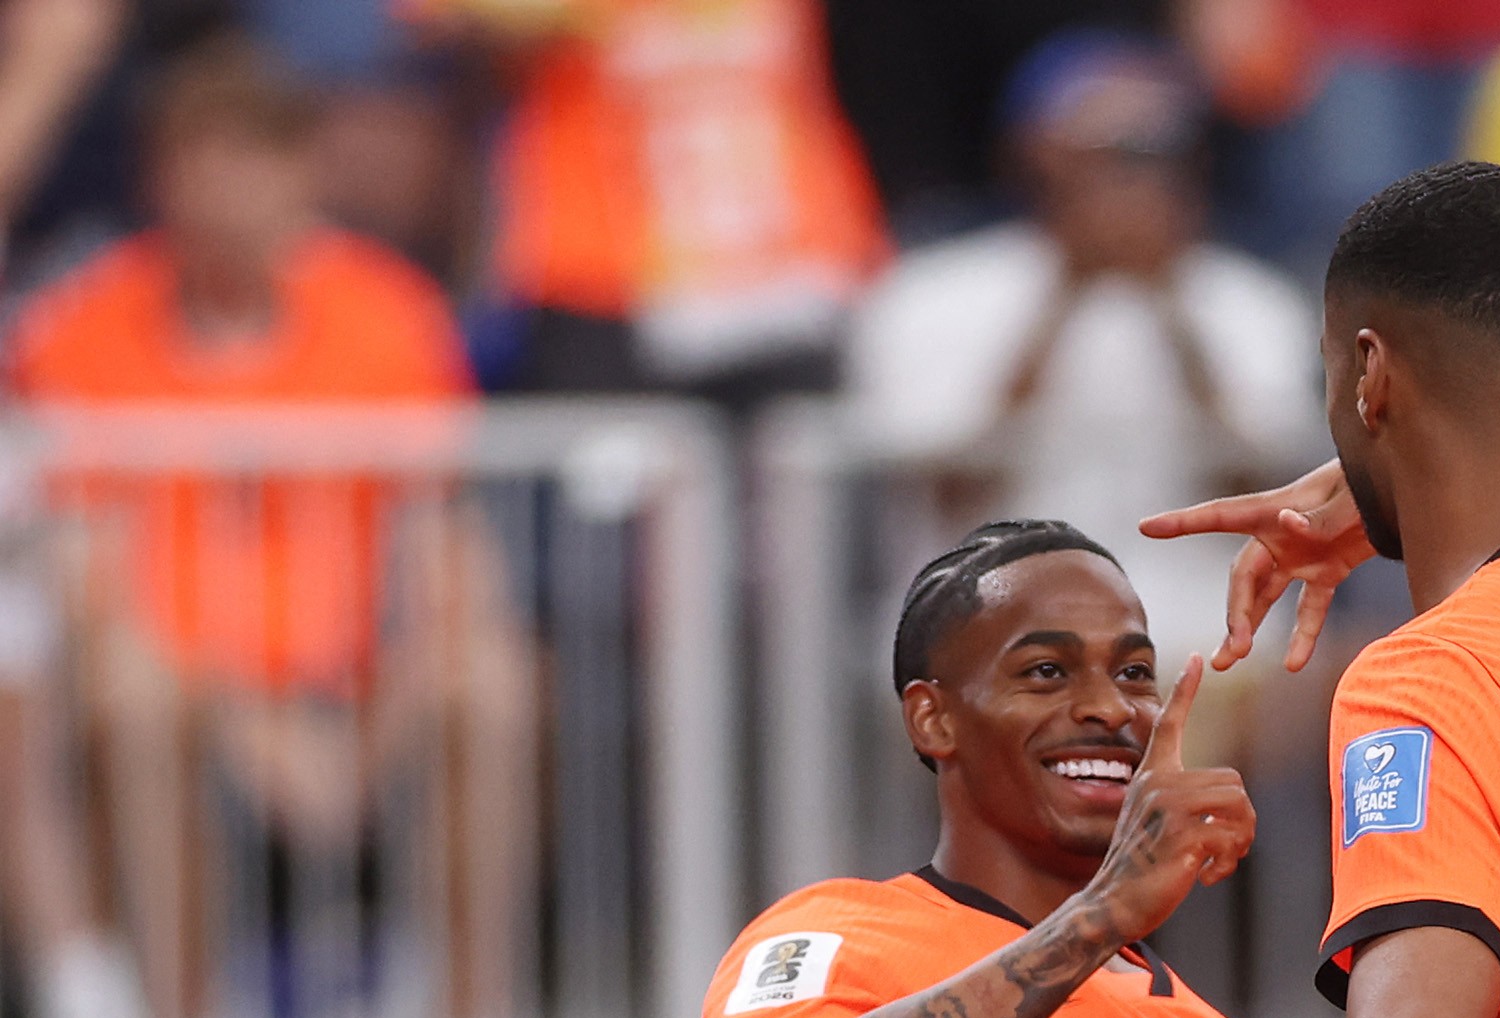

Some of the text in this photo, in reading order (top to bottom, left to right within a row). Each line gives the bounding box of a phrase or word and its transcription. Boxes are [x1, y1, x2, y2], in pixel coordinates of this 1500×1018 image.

[1382, 771, 1403, 791] For
[1355, 791, 1398, 817] PEACE
[1359, 812, 1386, 825] FIFA
